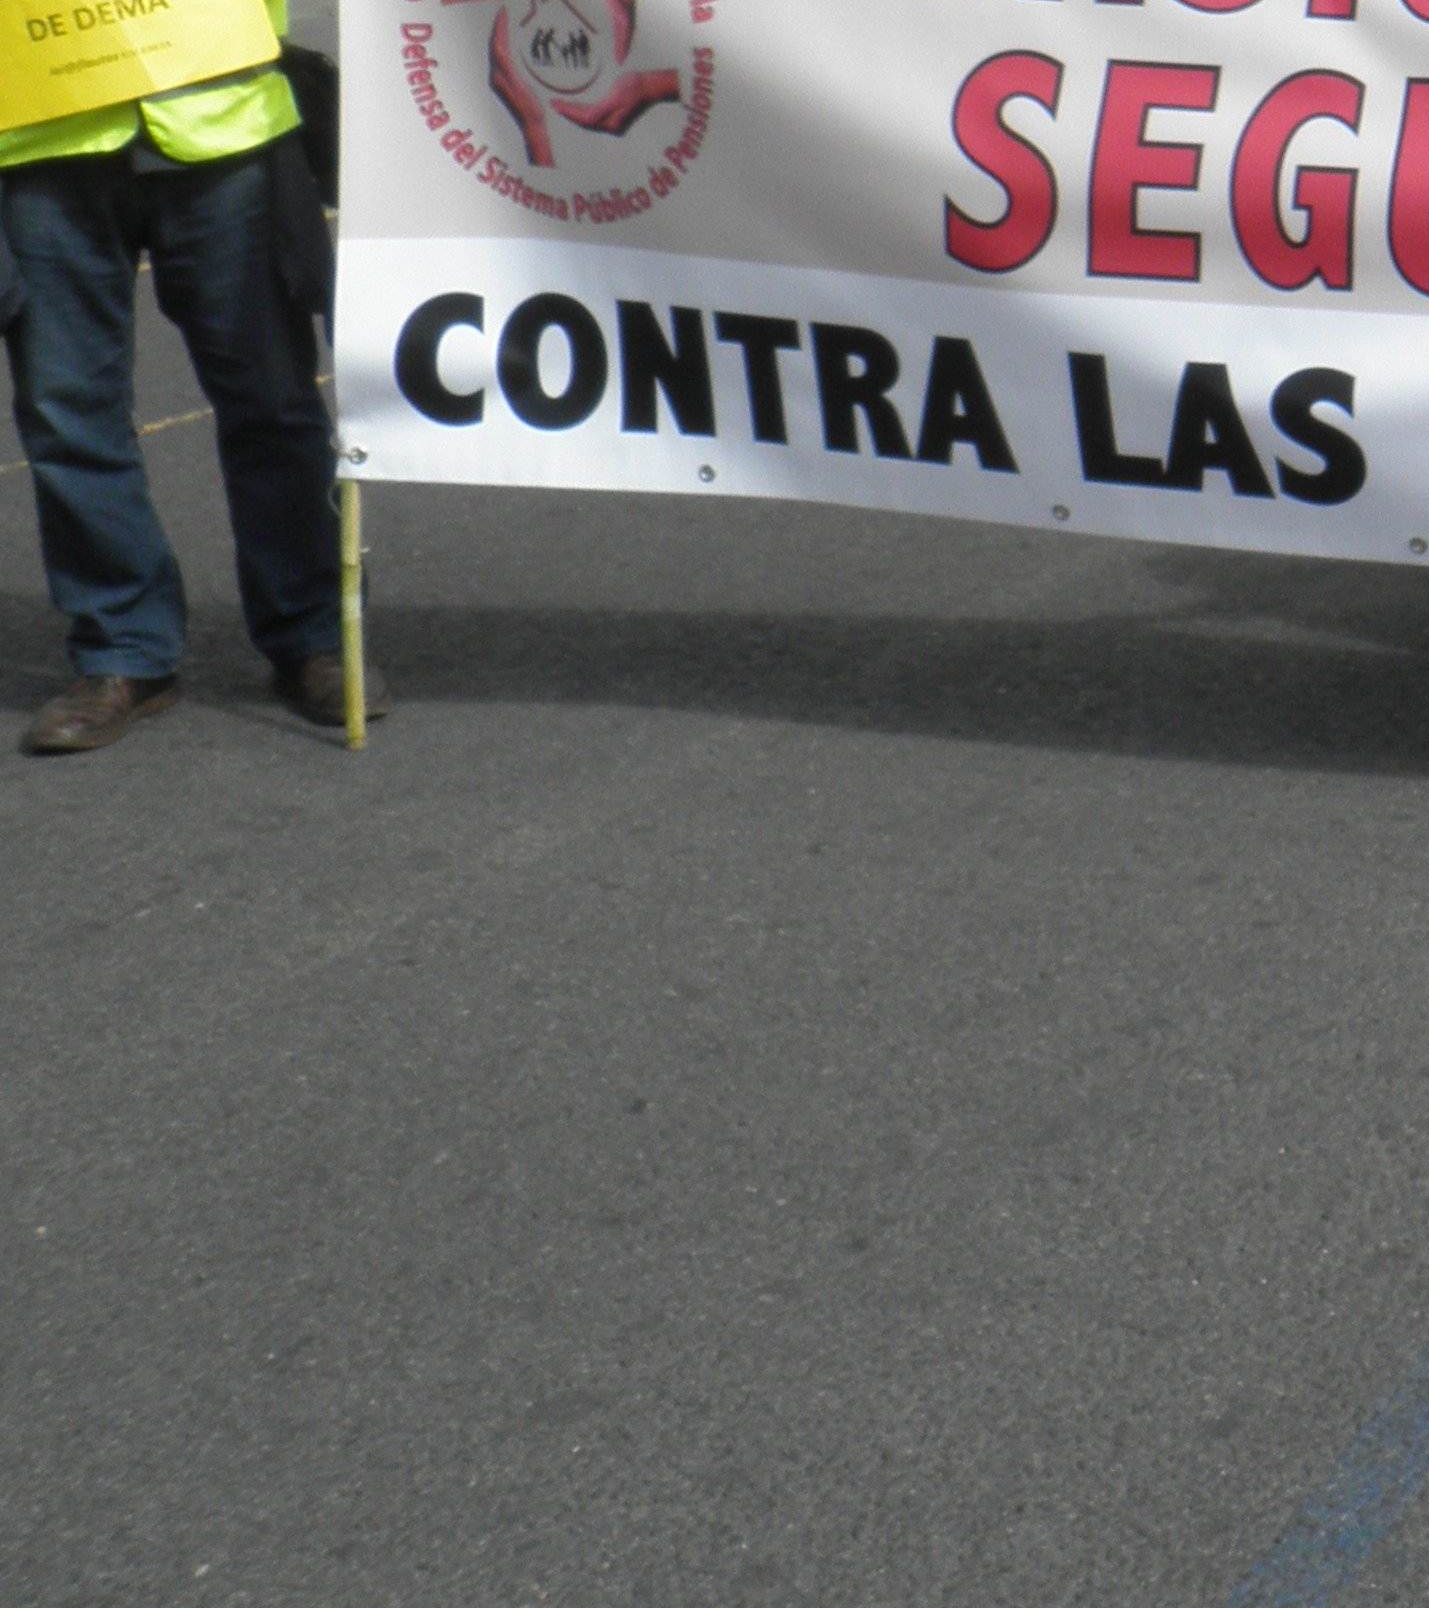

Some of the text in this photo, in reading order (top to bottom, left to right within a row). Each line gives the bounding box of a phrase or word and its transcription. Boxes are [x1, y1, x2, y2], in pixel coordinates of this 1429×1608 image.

[26, 11, 68, 42] DE
[401, 21, 449, 131] Defensa
[440, 128, 488, 170] del
[477, 157, 569, 222] Sistema
[648, 165, 680, 199] de
[664, 47, 715, 174] Pensiones
[394, 290, 1020, 475] CONTRA
[1067, 350, 1368, 506] LAS
